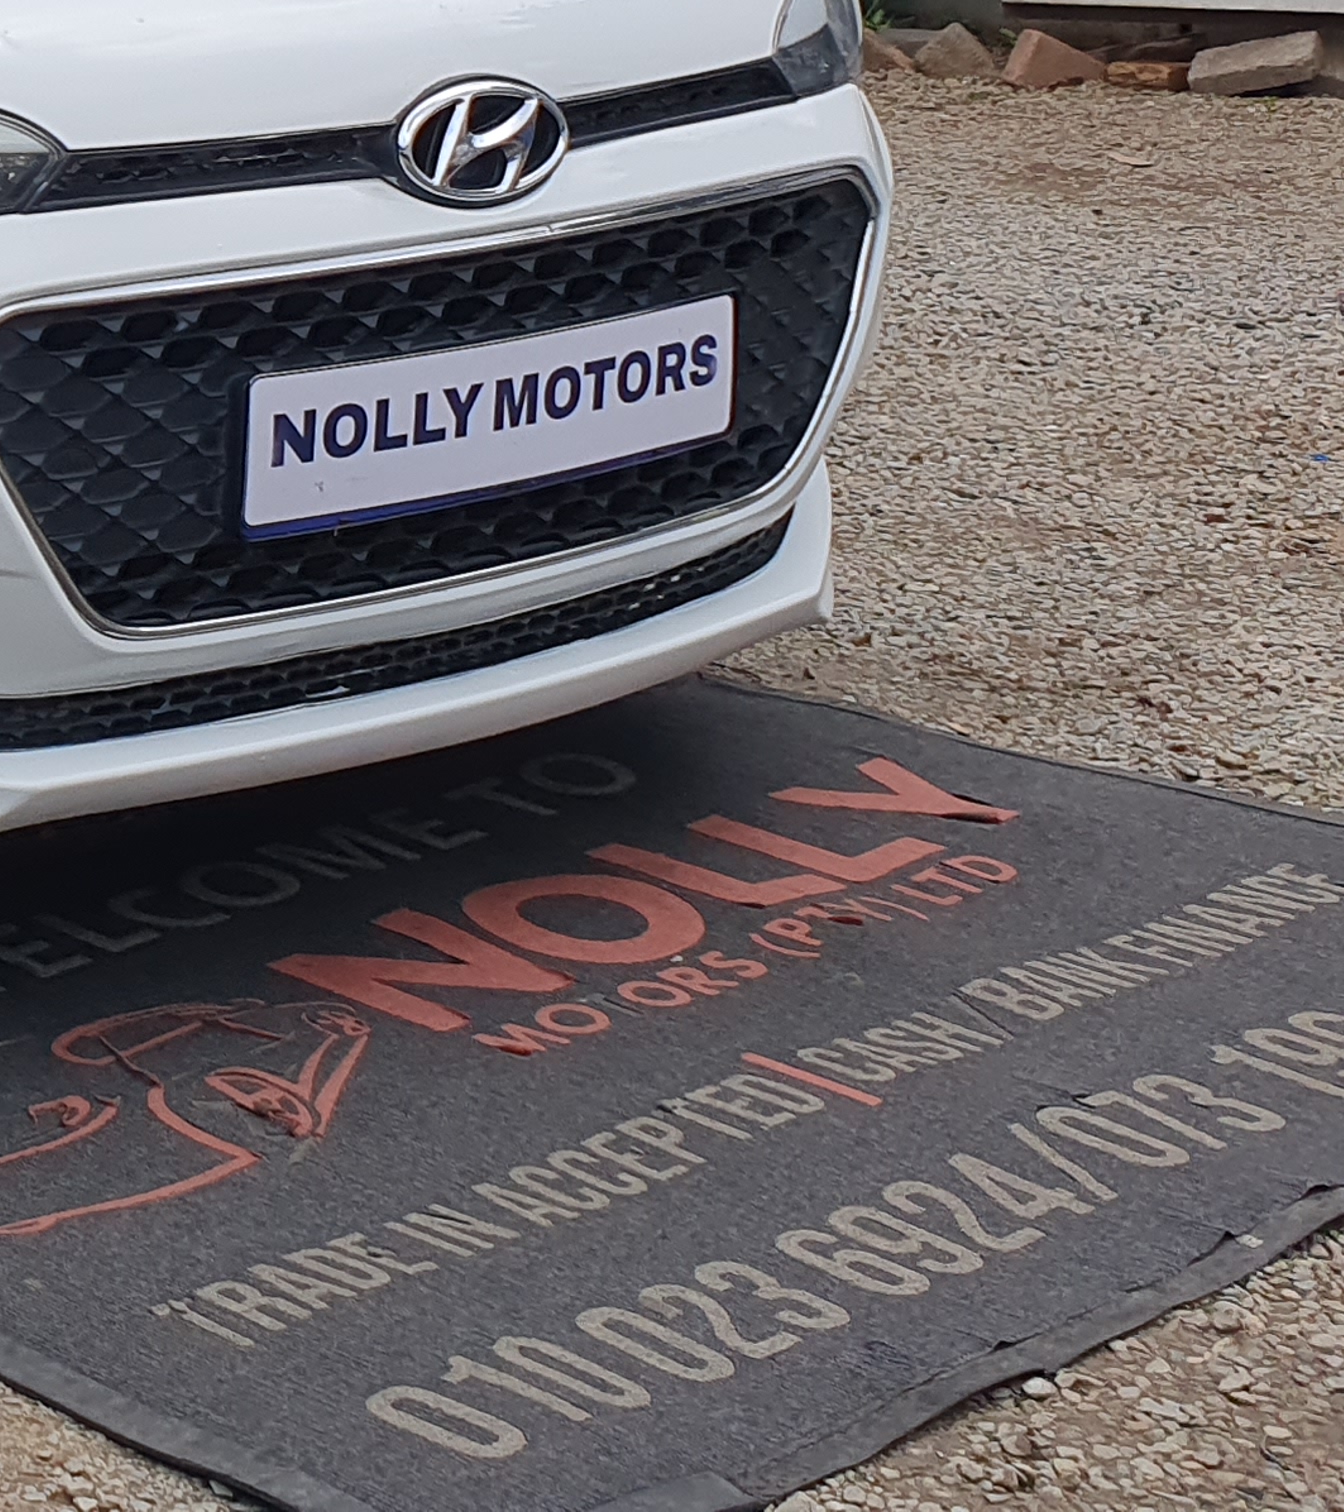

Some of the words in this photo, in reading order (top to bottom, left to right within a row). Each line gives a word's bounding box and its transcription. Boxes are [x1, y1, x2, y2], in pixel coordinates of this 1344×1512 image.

[270, 382, 484, 468] NOLLY
[492, 334, 718, 431] MOTORS
[443, 752, 637, 816] TO
[267, 754, 1020, 1032] NOLLY
[890, 855, 1018, 907] LTD
[150, 1232, 438, 1348] TRADE
[382, 1202, 521, 1258] IN
[470, 1073, 826, 1228] ACCEPTED
[1103, 862, 1344, 967] FINANCE
[364, 1335, 652, 1459] 010
[574, 1260, 852, 1382] 023
